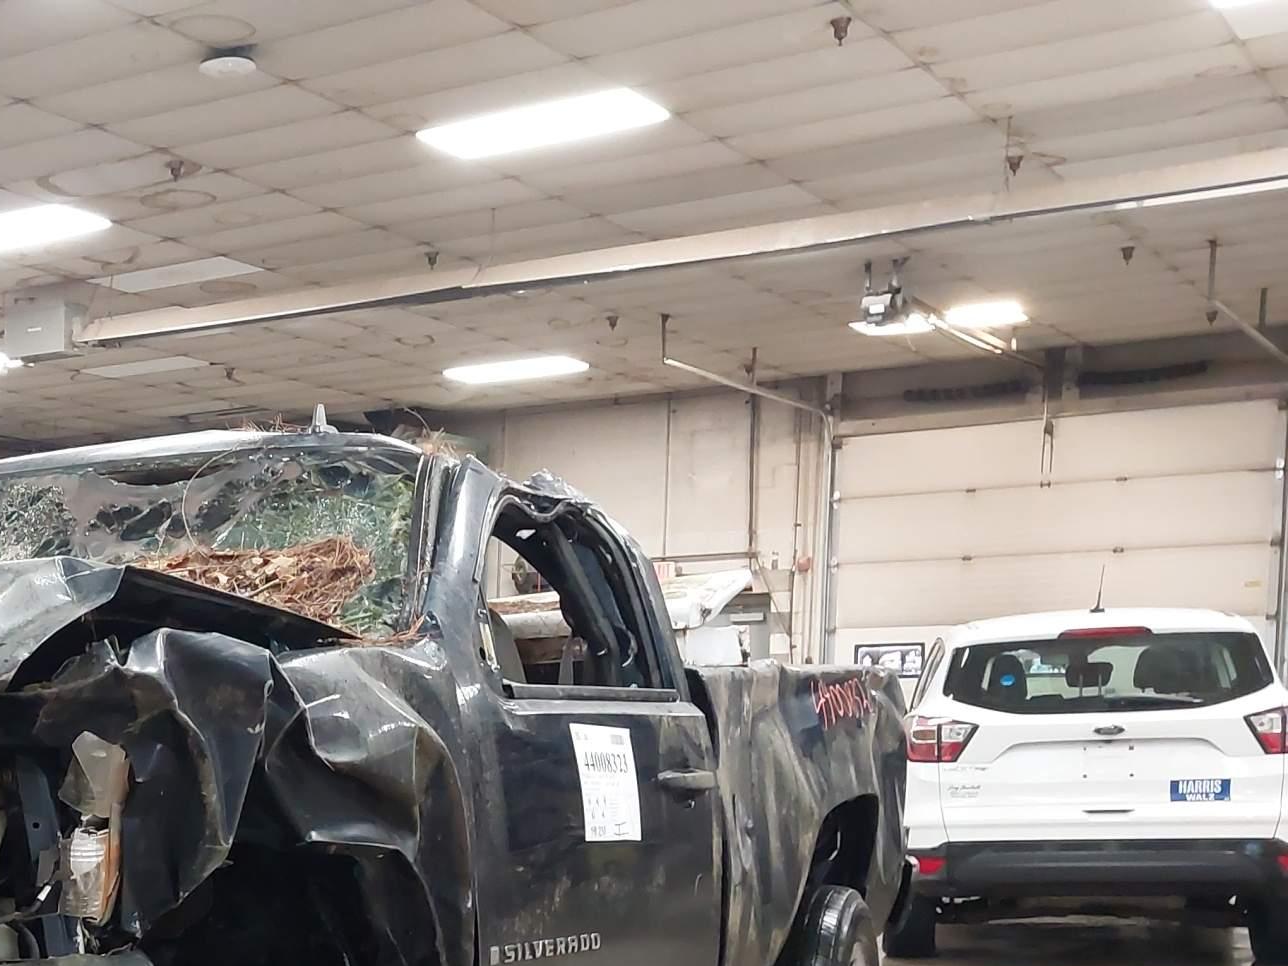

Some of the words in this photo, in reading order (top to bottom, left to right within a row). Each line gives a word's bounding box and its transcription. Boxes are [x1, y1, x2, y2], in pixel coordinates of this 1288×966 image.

[584, 751, 629, 773] 44008323
[1178, 779, 1222, 794] HARRIS
[1185, 793, 1215, 801] WALZ
[504, 932, 601, 963] SILVERADO
